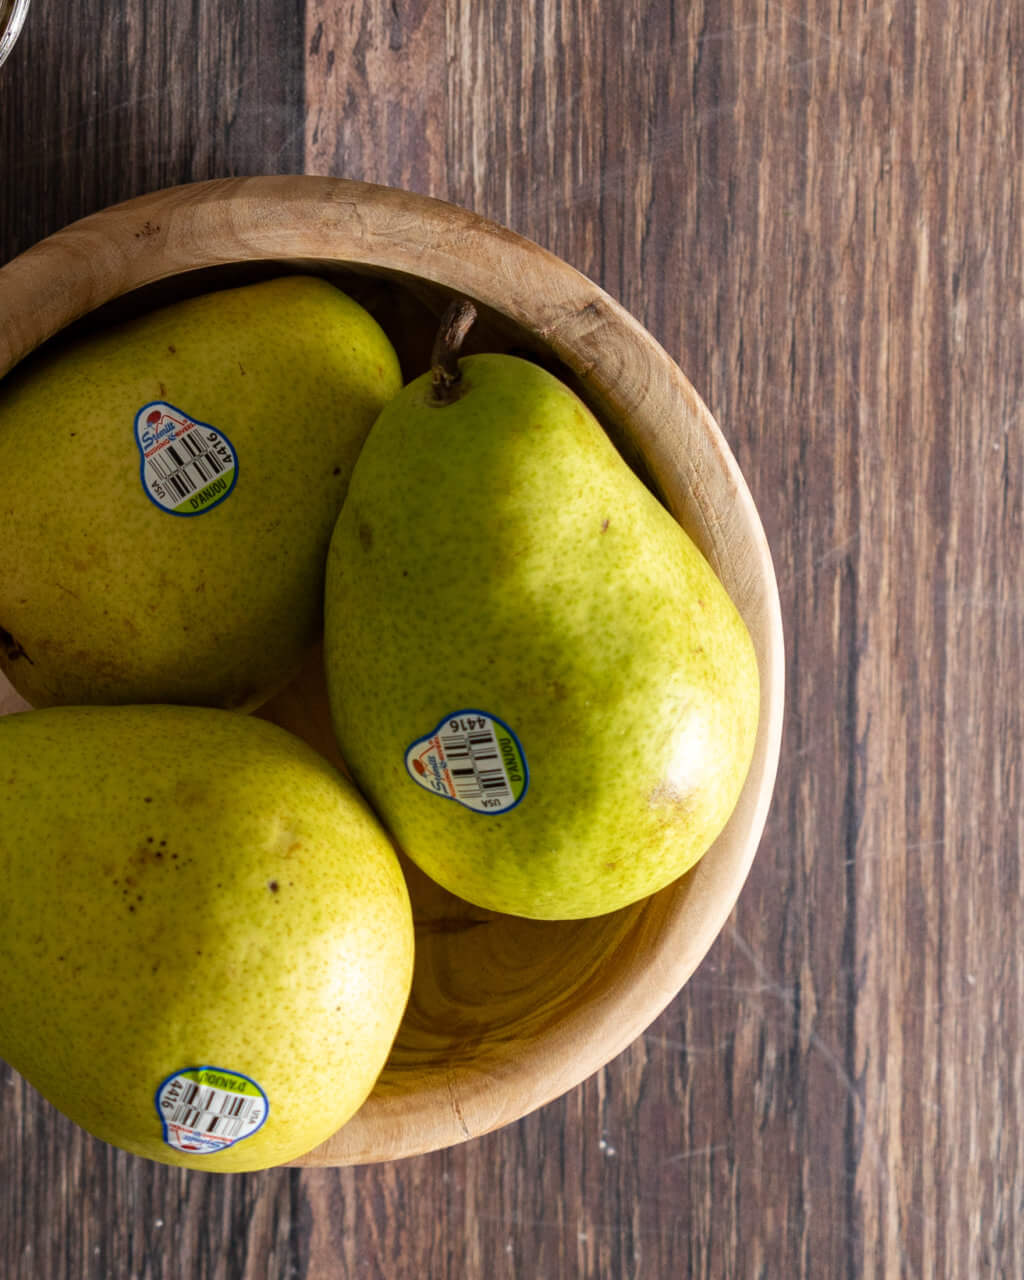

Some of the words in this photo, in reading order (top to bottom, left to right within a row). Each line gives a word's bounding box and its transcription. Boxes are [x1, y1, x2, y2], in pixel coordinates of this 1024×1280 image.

[207, 432, 232, 463] 4416
[151, 480, 166, 499] USA
[190, 478, 227, 509] D'ANJOU
[449, 716, 486, 732] 4416
[499, 738, 522, 782] D'ANJOU
[481, 799, 501, 808] USA
[161, 1080, 182, 1109] 4416
